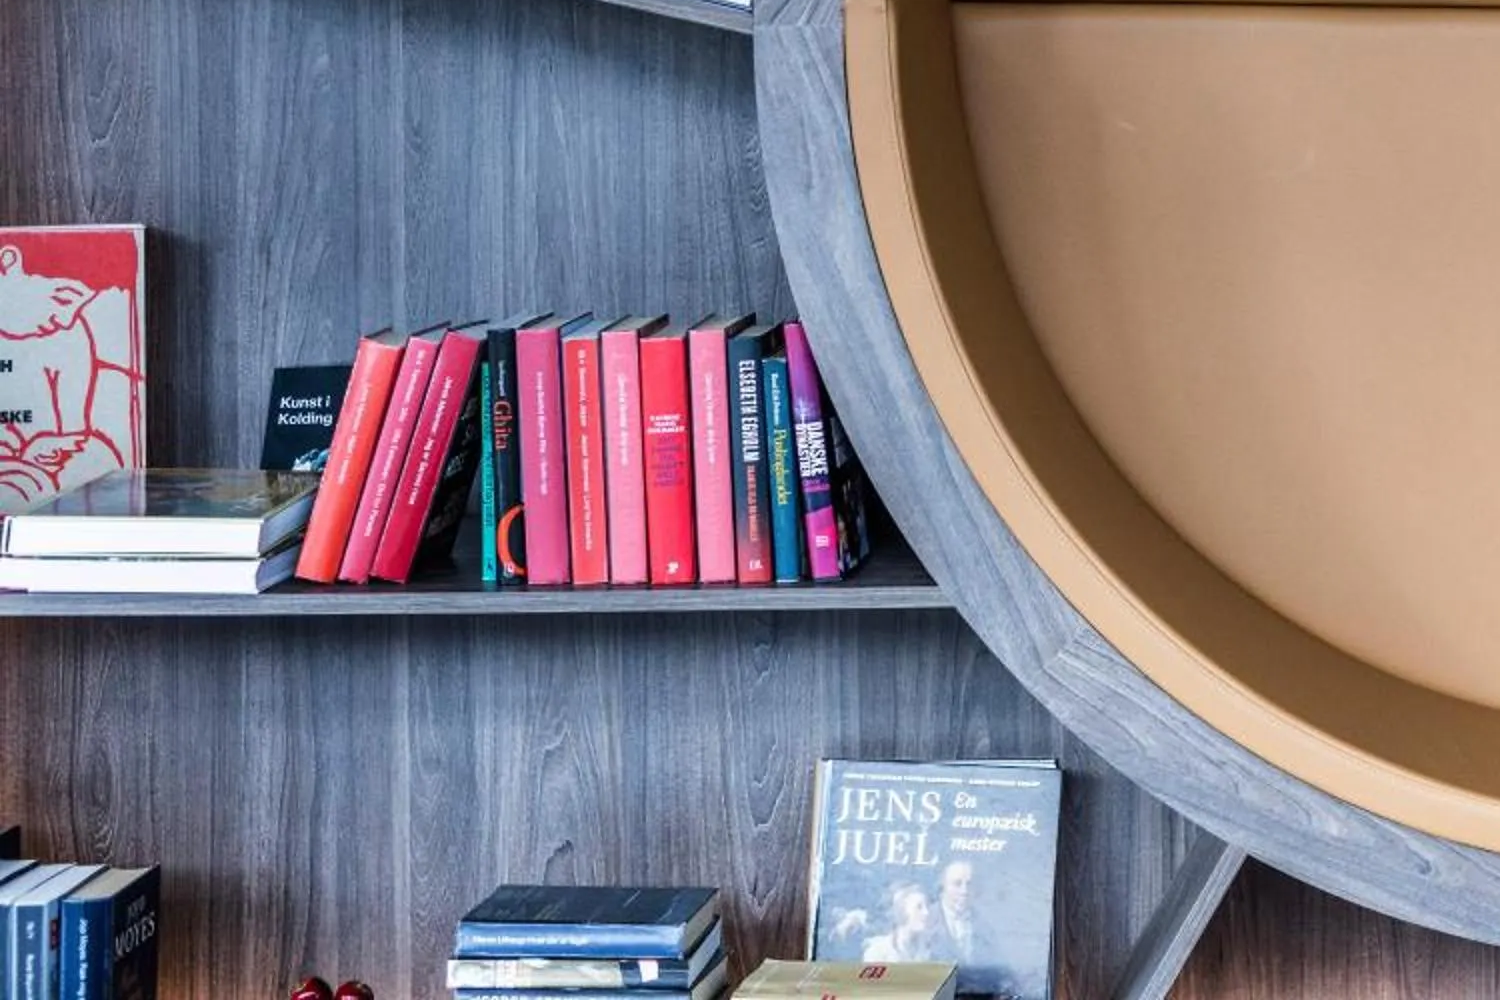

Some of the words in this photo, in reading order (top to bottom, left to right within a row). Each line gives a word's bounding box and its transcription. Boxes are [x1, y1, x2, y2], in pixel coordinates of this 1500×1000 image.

[280, 397, 324, 409] Kunst
[738, 360, 757, 415] ELSEBETH
[277, 413, 333, 426] Kolding
[495, 400, 514, 449] Ghita
[742, 418, 761, 463] EGHOLM
[807, 421, 829, 476] DANSKE
[837, 786, 942, 824] JENS
[954, 791, 977, 809] En
[832, 829, 940, 866] JUEL
[950, 837, 1008, 852] mester
[115, 912, 156, 958] MOYES
